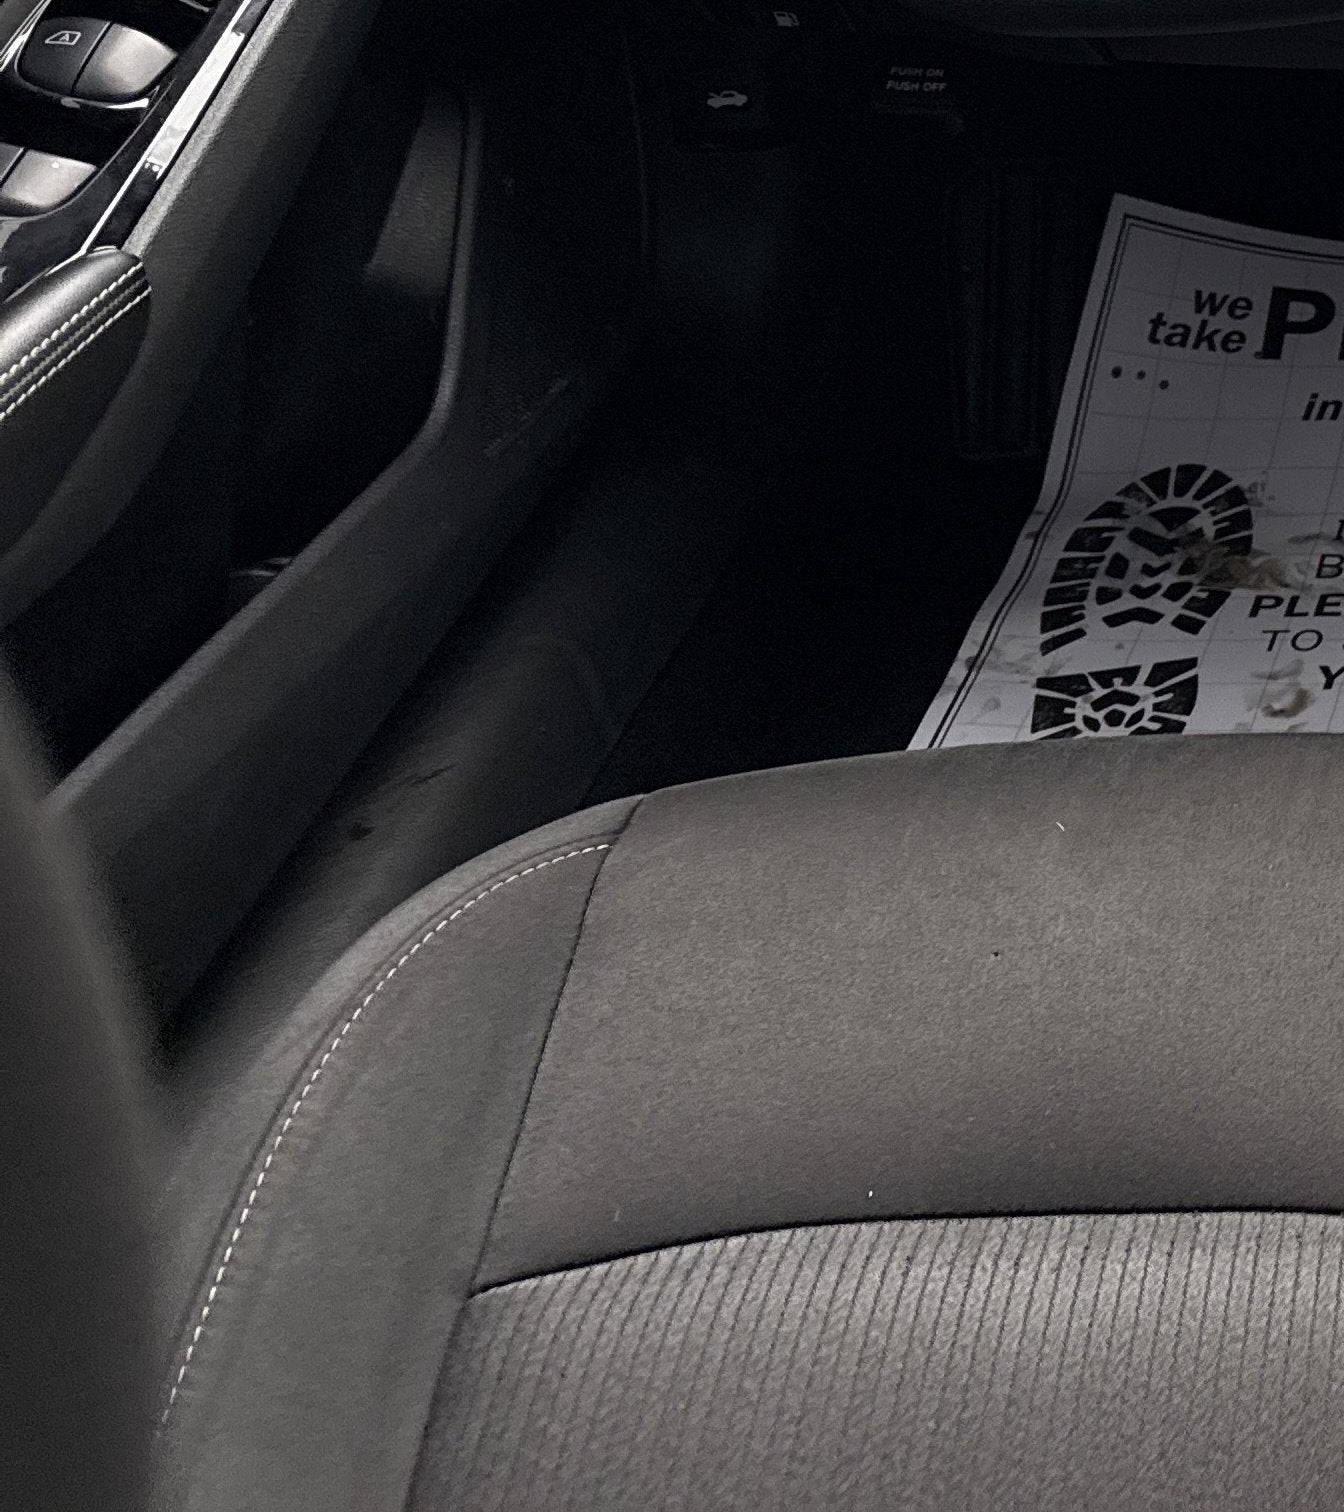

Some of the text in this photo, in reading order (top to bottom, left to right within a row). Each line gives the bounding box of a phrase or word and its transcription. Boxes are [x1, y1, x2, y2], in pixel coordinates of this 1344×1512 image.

[886, 80, 947, 92] PUSH OFF
[1192, 289, 1254, 320] we
[1146, 311, 1248, 355] take
[1300, 393, 1342, 422] in
[1260, 627, 1323, 652] TO
